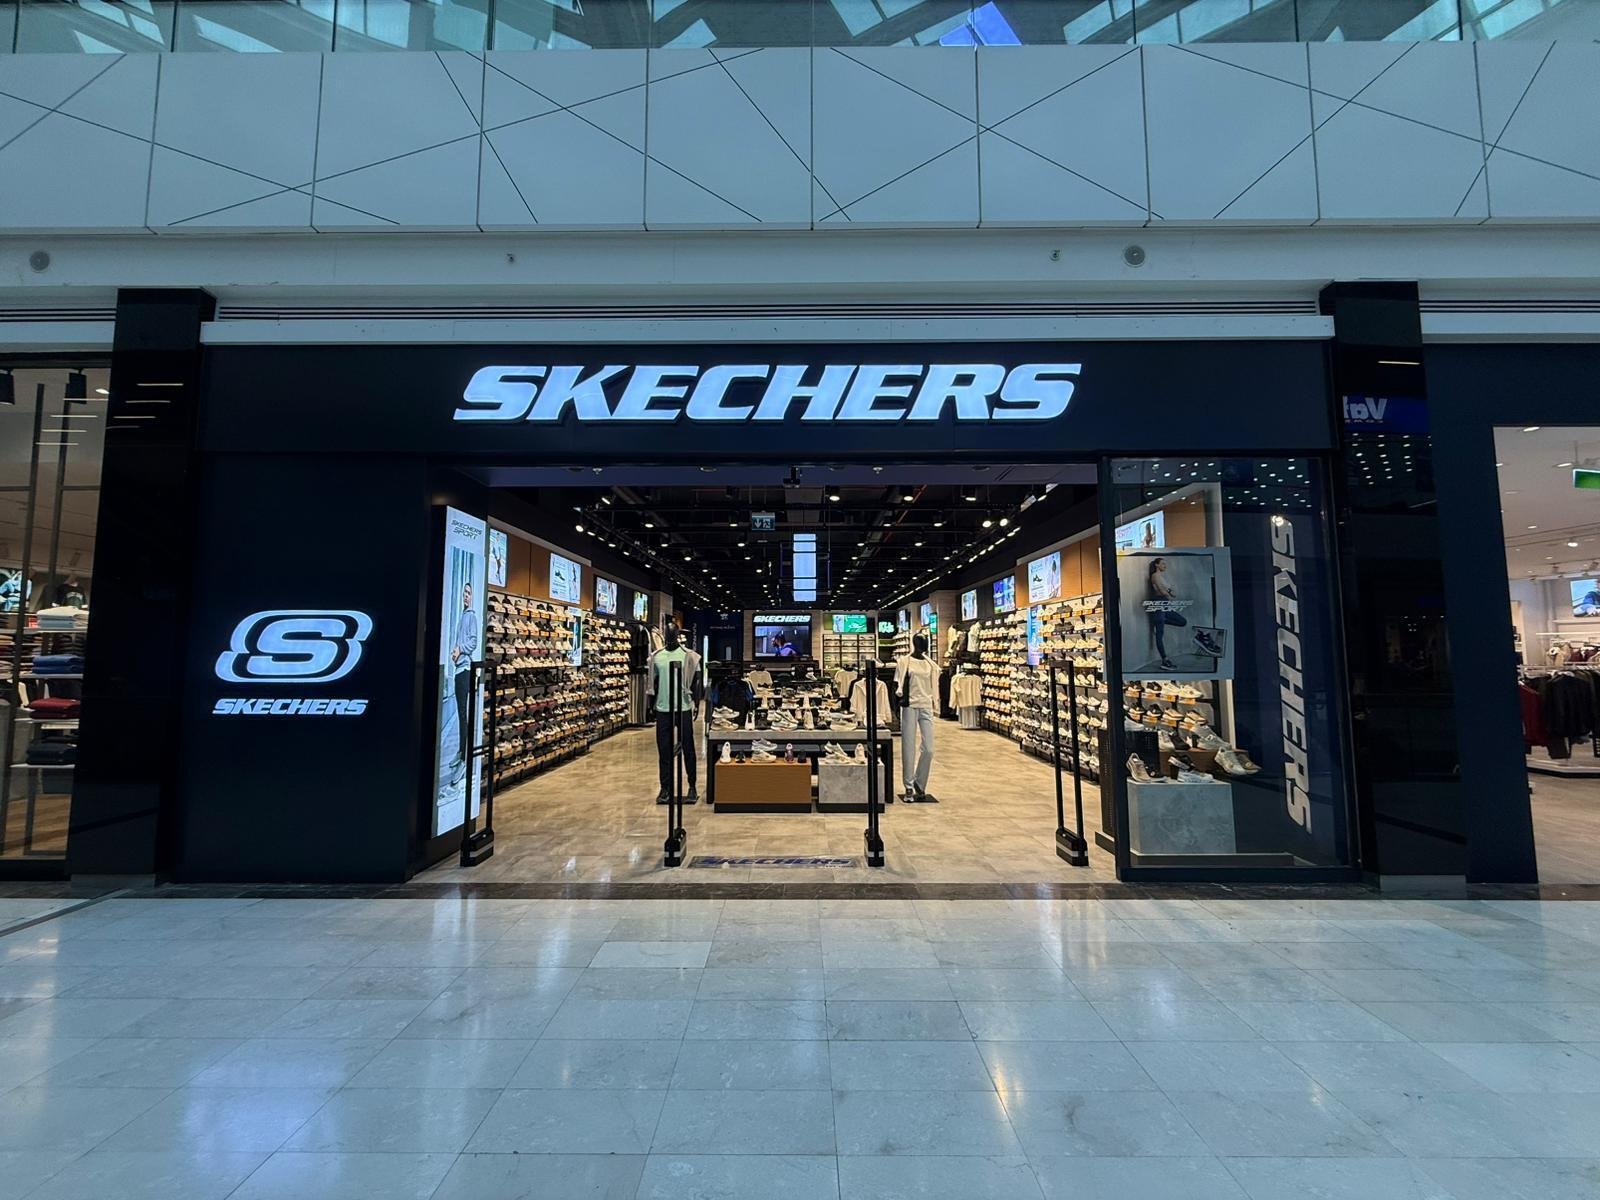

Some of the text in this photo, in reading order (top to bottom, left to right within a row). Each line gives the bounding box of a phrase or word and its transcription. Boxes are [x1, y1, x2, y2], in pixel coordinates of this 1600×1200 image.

[453, 364, 1082, 422] SKECHERS
[451, 519, 482, 536] SKECHERS
[453, 526, 478, 540] SPORT
[753, 615, 811, 623] SKECHERS
[1270, 515, 1312, 834] SKECHERS
[212, 698, 369, 716] SKECHERS
[701, 857, 851, 865] SKECHERS
